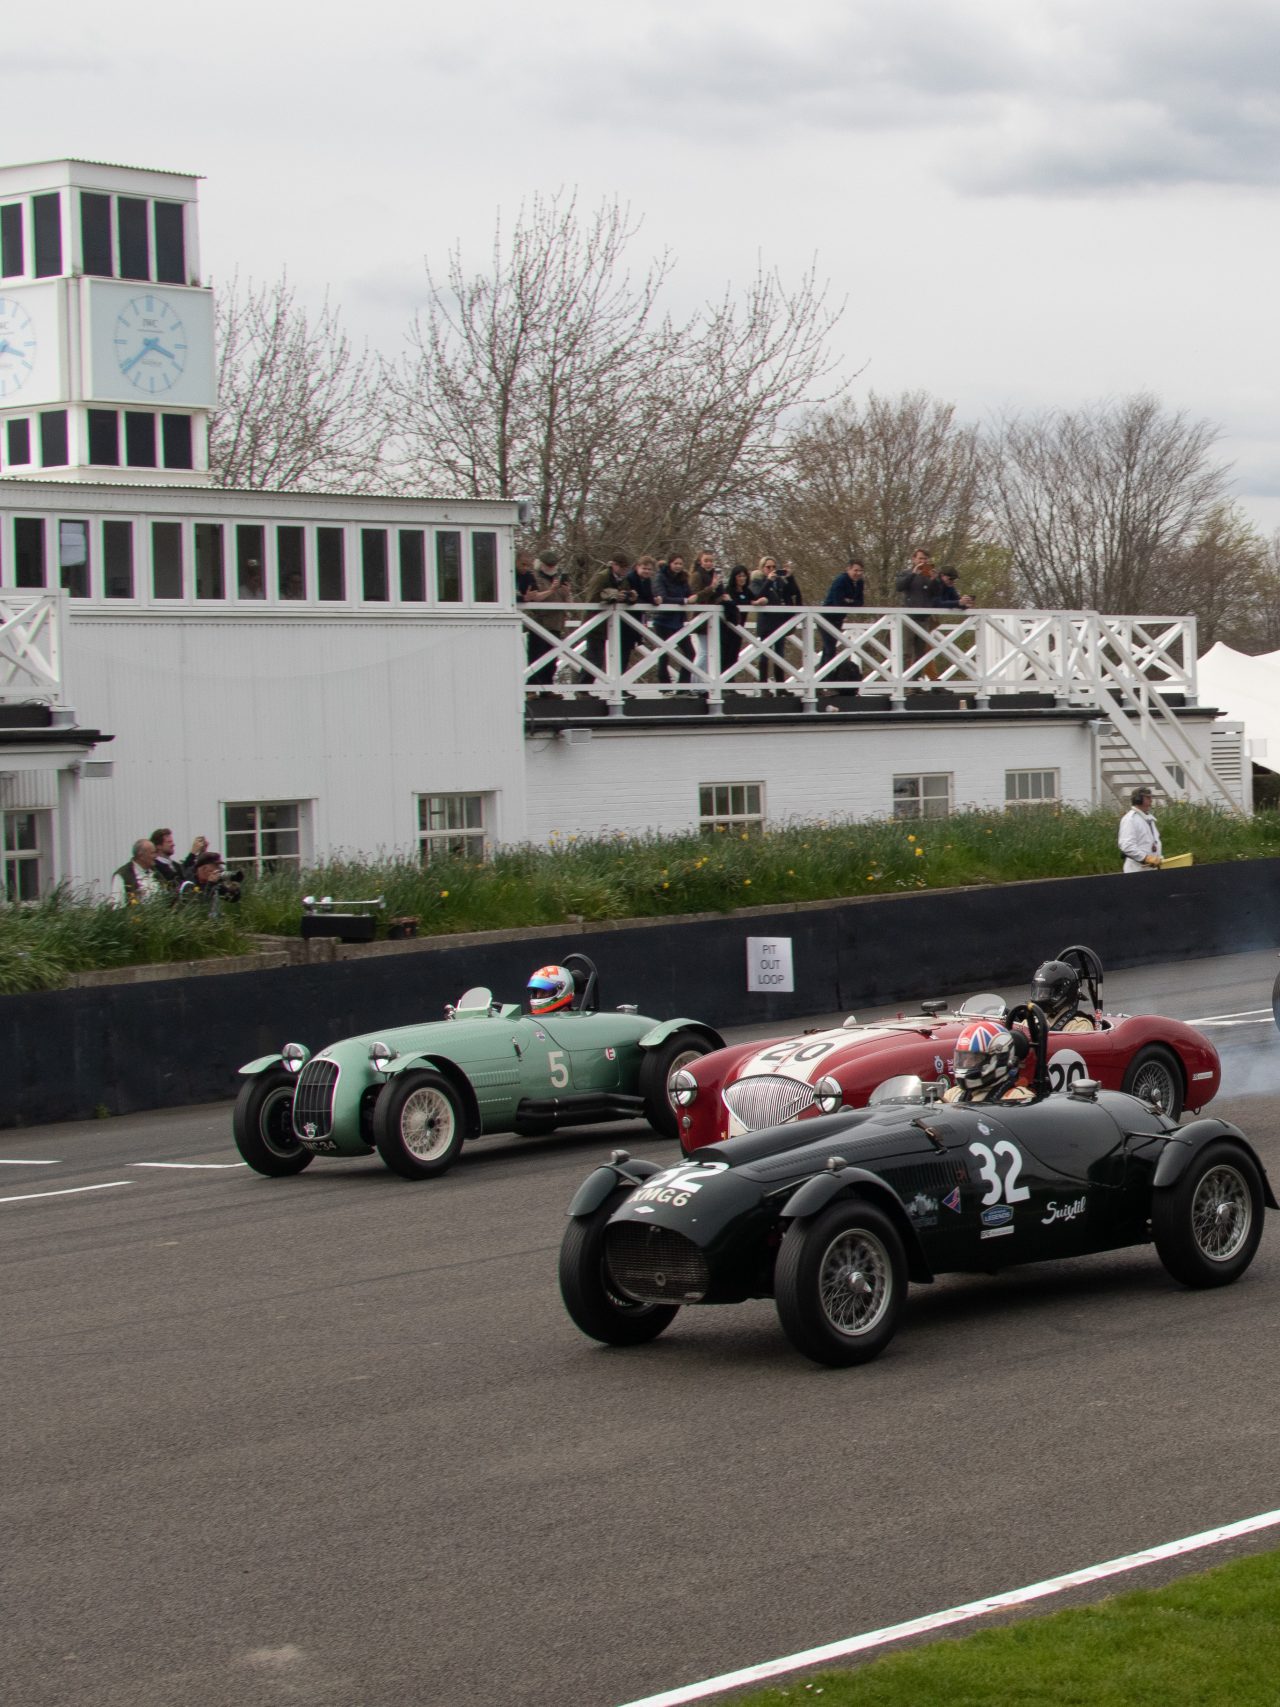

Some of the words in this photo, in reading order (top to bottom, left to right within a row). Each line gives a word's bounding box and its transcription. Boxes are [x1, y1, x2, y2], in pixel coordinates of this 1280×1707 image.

[762, 944, 777, 955] PIT
[760, 959, 781, 970] OUT
[758, 974, 785, 985] LOOP
[760, 1042, 835, 1062] 20
[548, 1051, 569, 1088] 5
[1048, 1061, 1086, 1092] 20
[642, 1161, 730, 1194] 32
[969, 1140, 1030, 1206] 32
